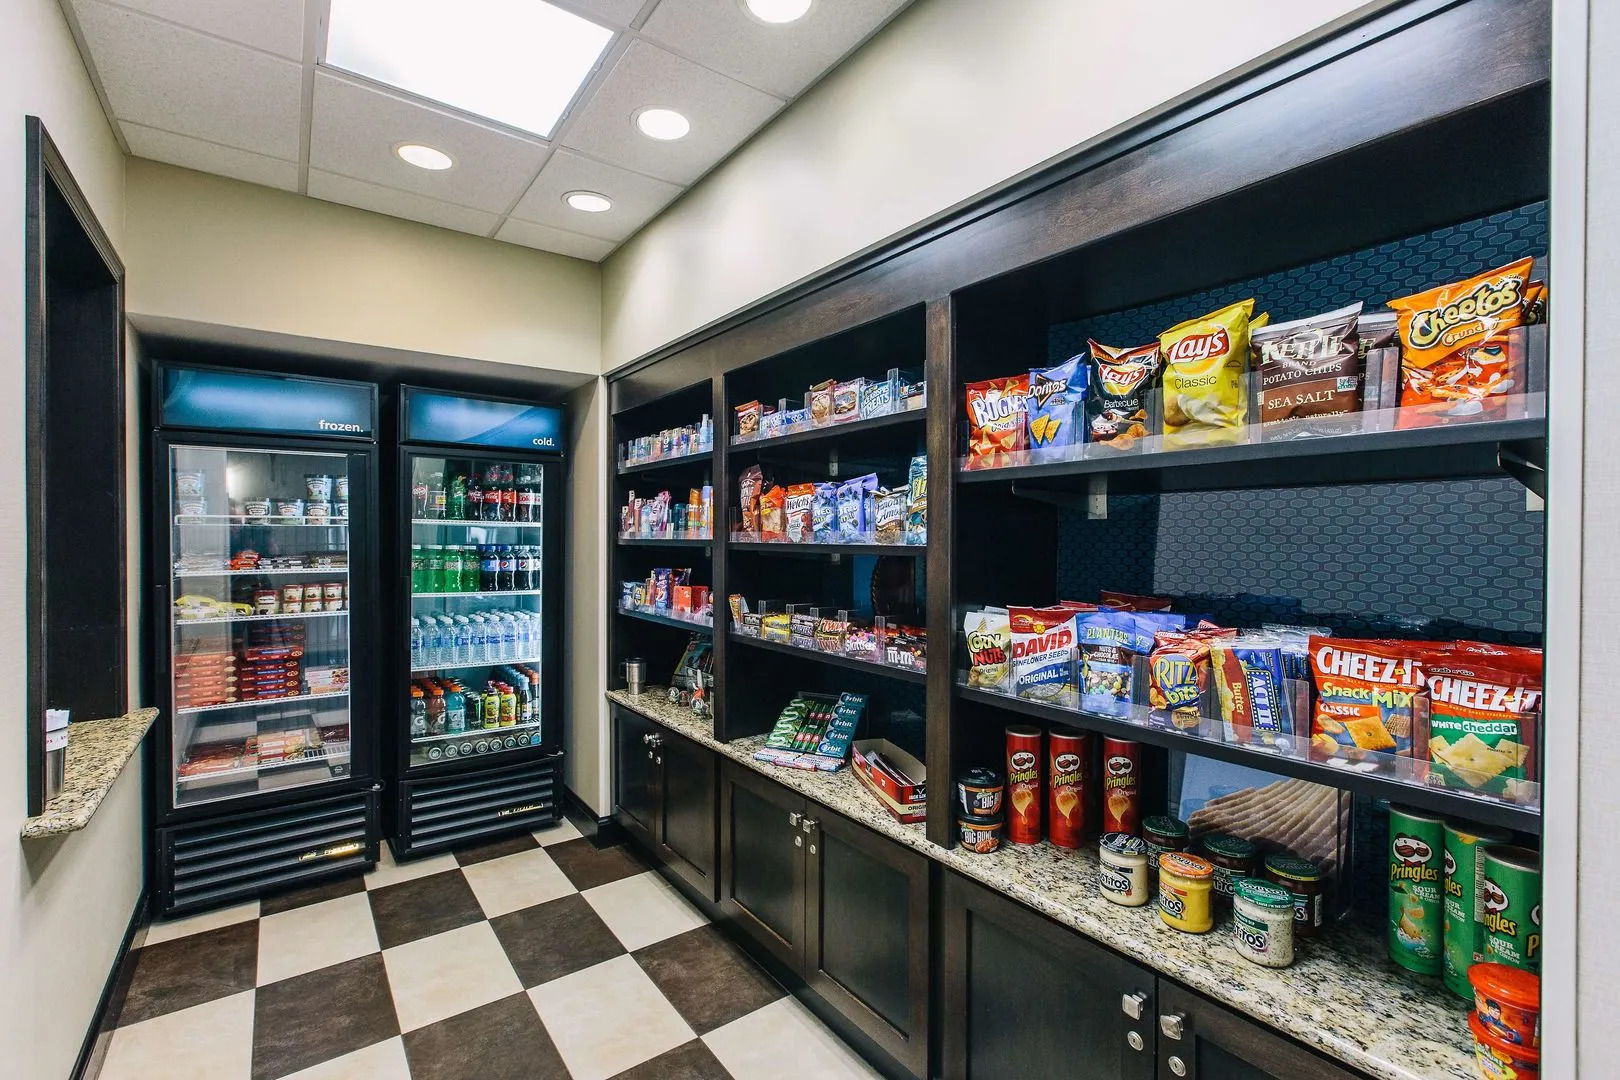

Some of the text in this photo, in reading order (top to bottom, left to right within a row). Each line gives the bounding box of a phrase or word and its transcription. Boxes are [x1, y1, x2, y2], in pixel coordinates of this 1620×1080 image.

[1410, 279, 1520, 346] Cheetos
[1169, 330, 1226, 364] Lay's
[1174, 374, 1217, 390] Classic
[1263, 370, 1302, 386] POTATO
[1304, 362, 1342, 377] CHIPS
[1028, 379, 1066, 400] Doritos
[1103, 398, 1139, 408] Barbecue
[1268, 389, 1335, 410] SEA SALT
[318, 419, 364, 433] frozen.
[532, 437, 555, 447] cold.
[787, 496, 810, 511] Welch's
[967, 631, 1001, 653] CORN
[1012, 629, 1073, 659] DAVID
[973, 648, 1007, 667] NUTS
[1012, 650, 1069, 668] SUNFLOWER SEEDS
[1316, 645, 1426, 687] CHEEZ-IT
[1019, 669, 1059, 685] ORIGINAL
[1154, 657, 1196, 690] RITZ
[1164, 685, 1198, 705] bits
[1232, 682, 1245, 715] Butter
[1252, 676, 1270, 708] ACT
[1322, 681, 1370, 700] Snack
[1372, 686, 1415, 709] Mix
[1320, 703, 1361, 716] CLASSIC
[1431, 720, 1461, 730] WHITE
[1463, 721, 1517, 735] cheddar
[1010, 769, 1038, 785] Pringles
[1054, 770, 1083, 788] Pringles
[1106, 774, 1137, 791] Pringles
[964, 831, 976, 844] BIG
[1390, 863, 1438, 882] Pringles
[1412, 885, 1437, 893] SOUR
